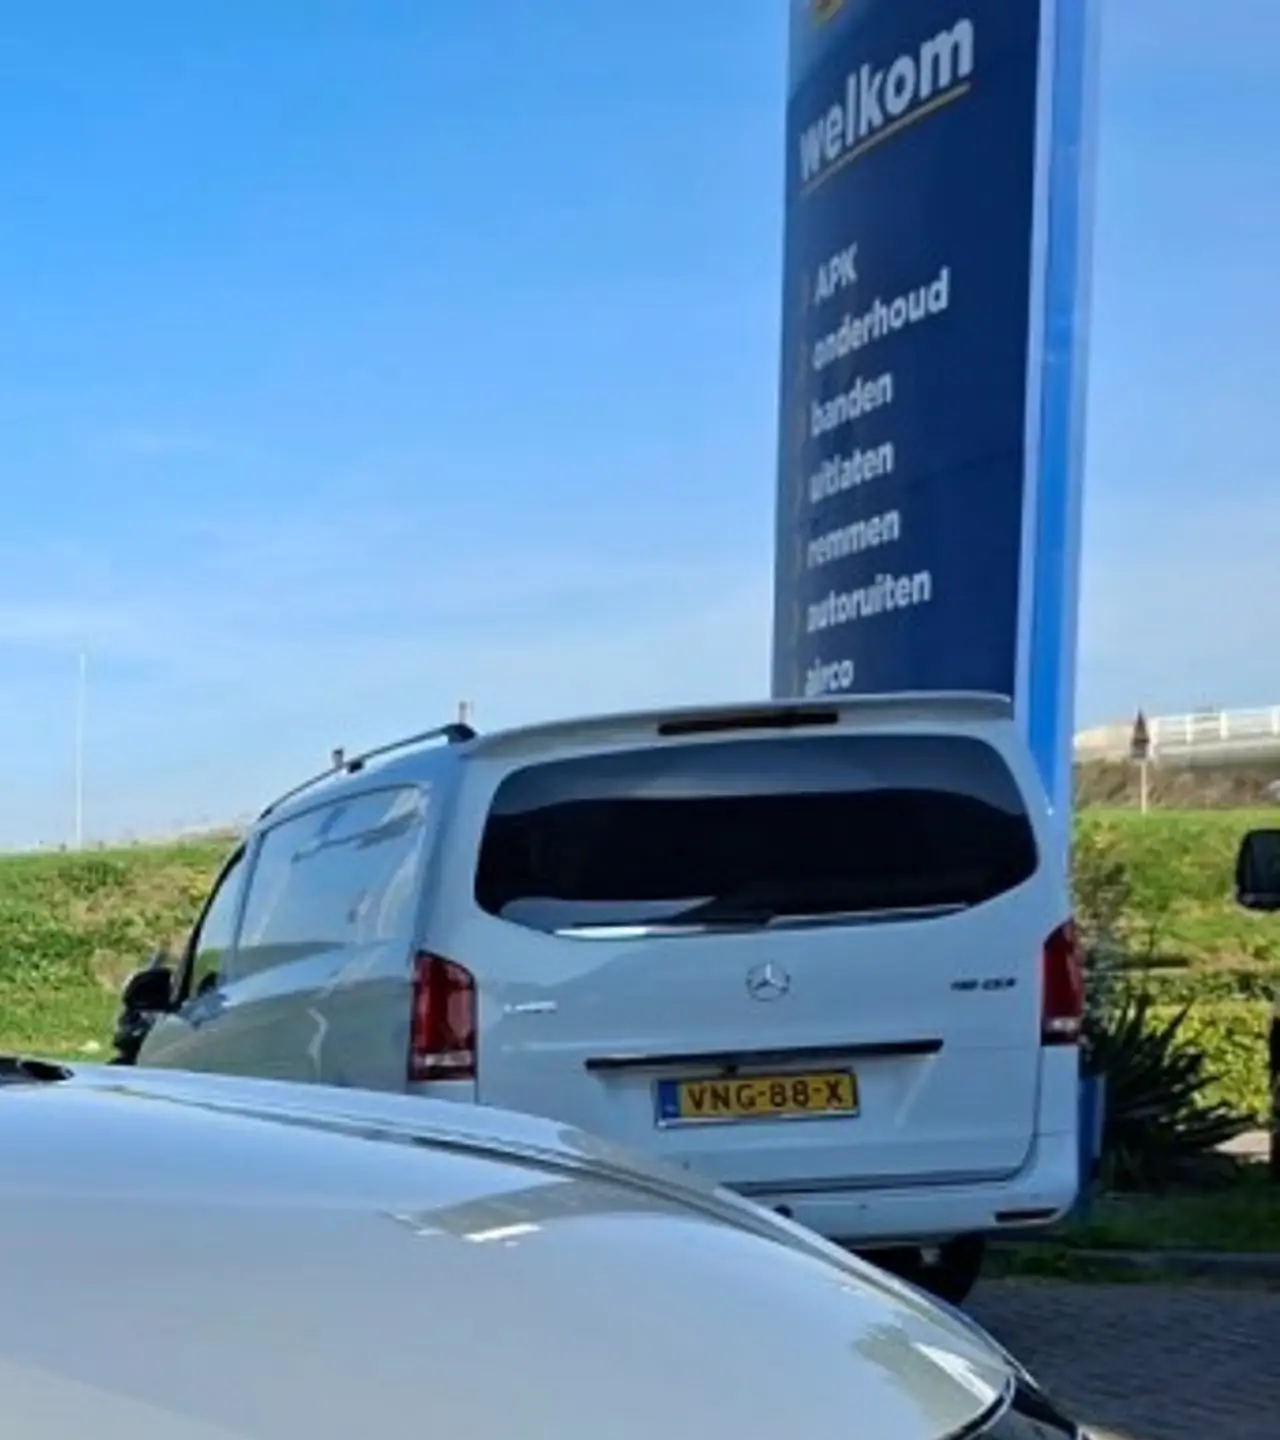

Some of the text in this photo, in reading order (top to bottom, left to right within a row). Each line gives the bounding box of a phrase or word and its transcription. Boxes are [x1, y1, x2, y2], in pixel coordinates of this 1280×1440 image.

[799, 18, 974, 181] welkom
[814, 241, 858, 305] APK
[813, 264, 950, 371] onderhoud
[811, 372, 892, 437] banden
[808, 441, 895, 504] uitlaten
[807, 508, 900, 568] remmen
[807, 570, 932, 632] autoruiten
[687, 1078, 845, 1113] VNG-88-X
